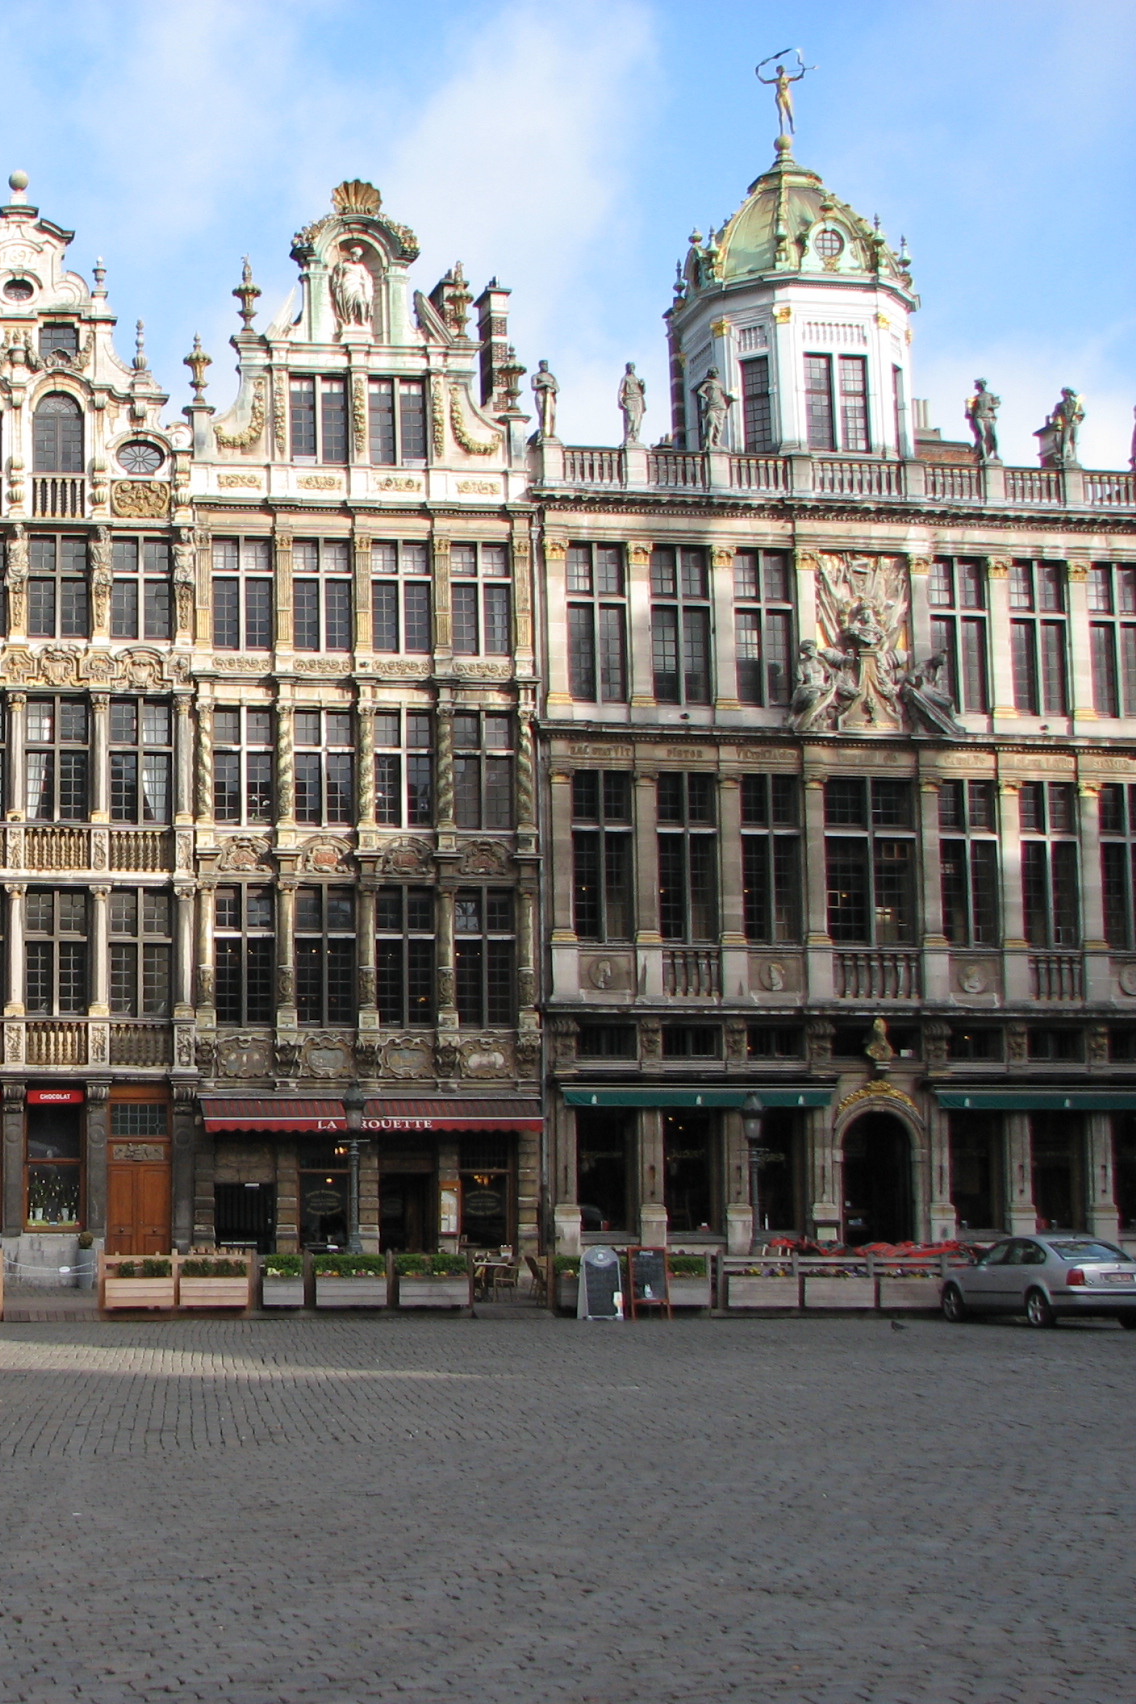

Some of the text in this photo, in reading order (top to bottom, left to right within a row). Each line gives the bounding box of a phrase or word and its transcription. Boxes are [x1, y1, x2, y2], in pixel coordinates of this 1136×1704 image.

[2, 250, 35, 263] 1697
[317, 1120, 433, 1129] LA ROUETTE
